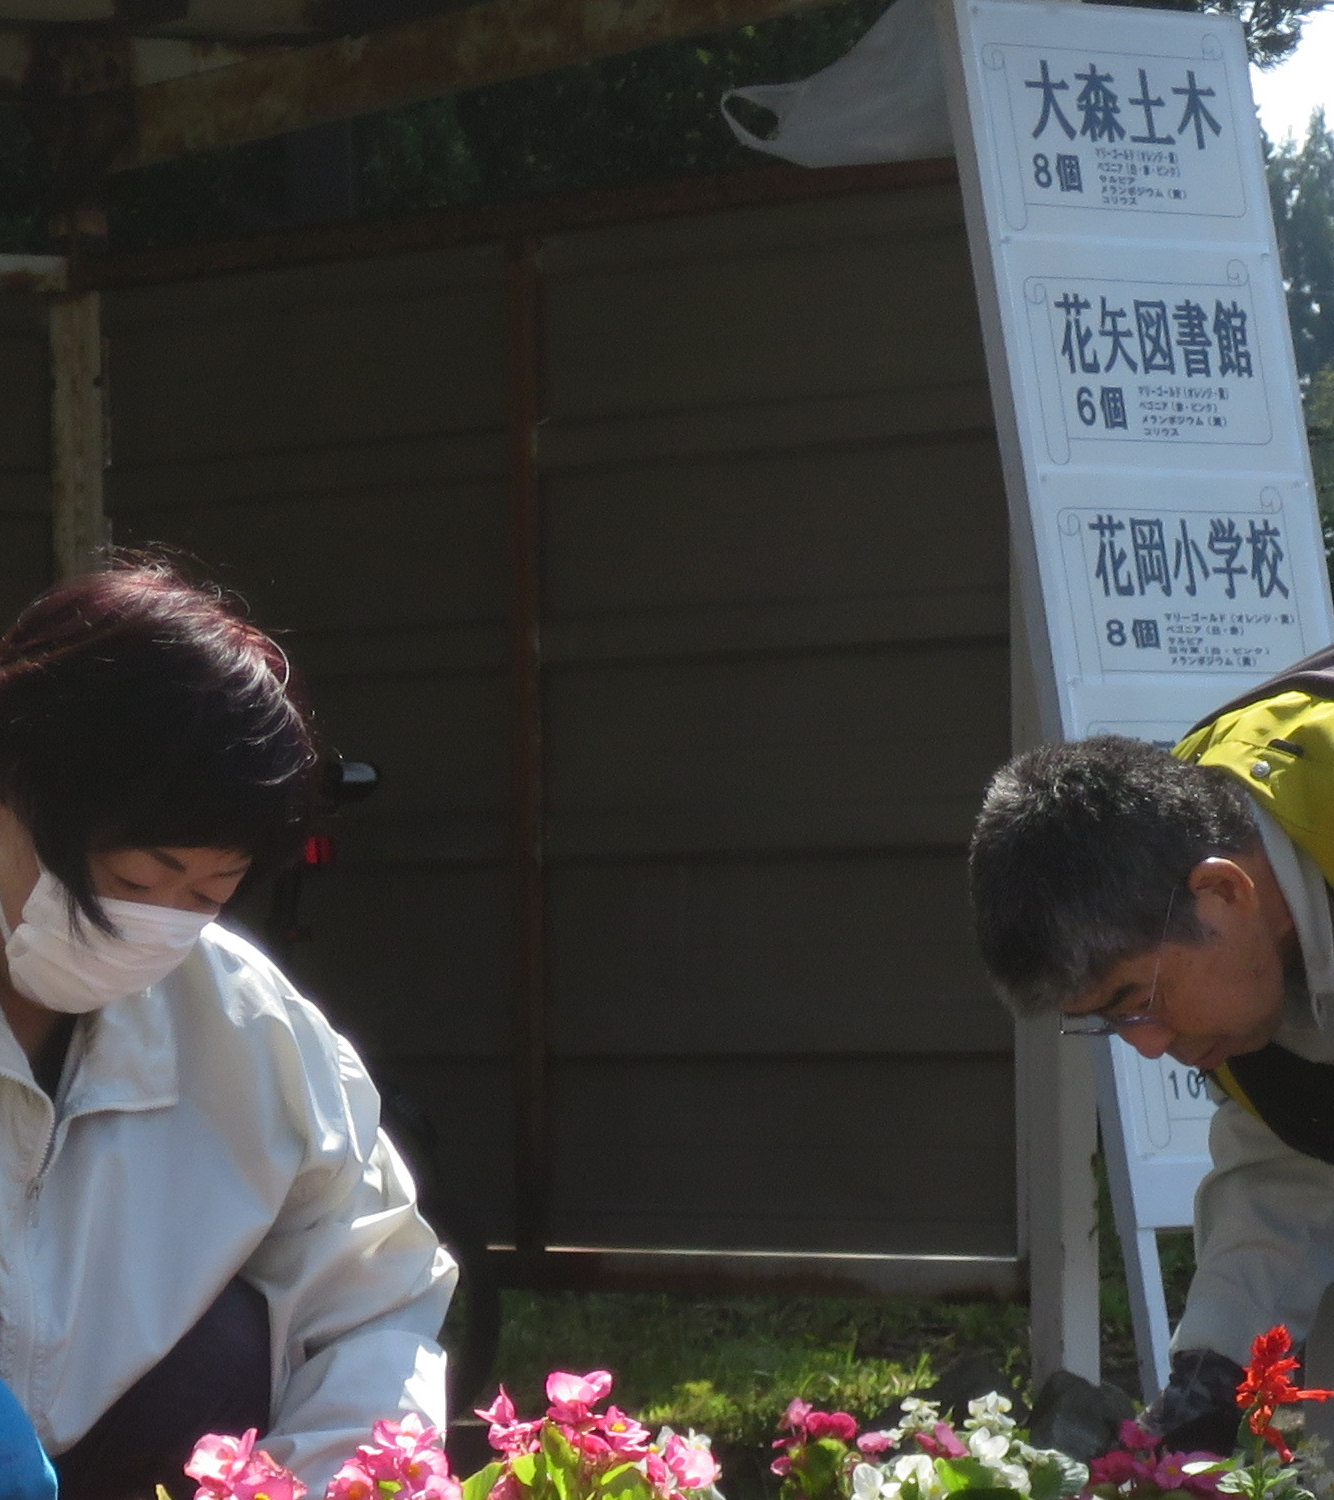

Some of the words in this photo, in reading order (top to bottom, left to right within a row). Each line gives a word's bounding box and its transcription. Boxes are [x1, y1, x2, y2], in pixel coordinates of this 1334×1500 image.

[1024, 59, 1223, 150] 大森土木
[1032, 153, 1083, 193] 8個
[1054, 293, 1255, 378] 花矢図書館
[1076, 386, 1128, 430] 6個
[1088, 514, 1290, 600] 花岡小学校
[1105, 619, 1161, 649] 8個
